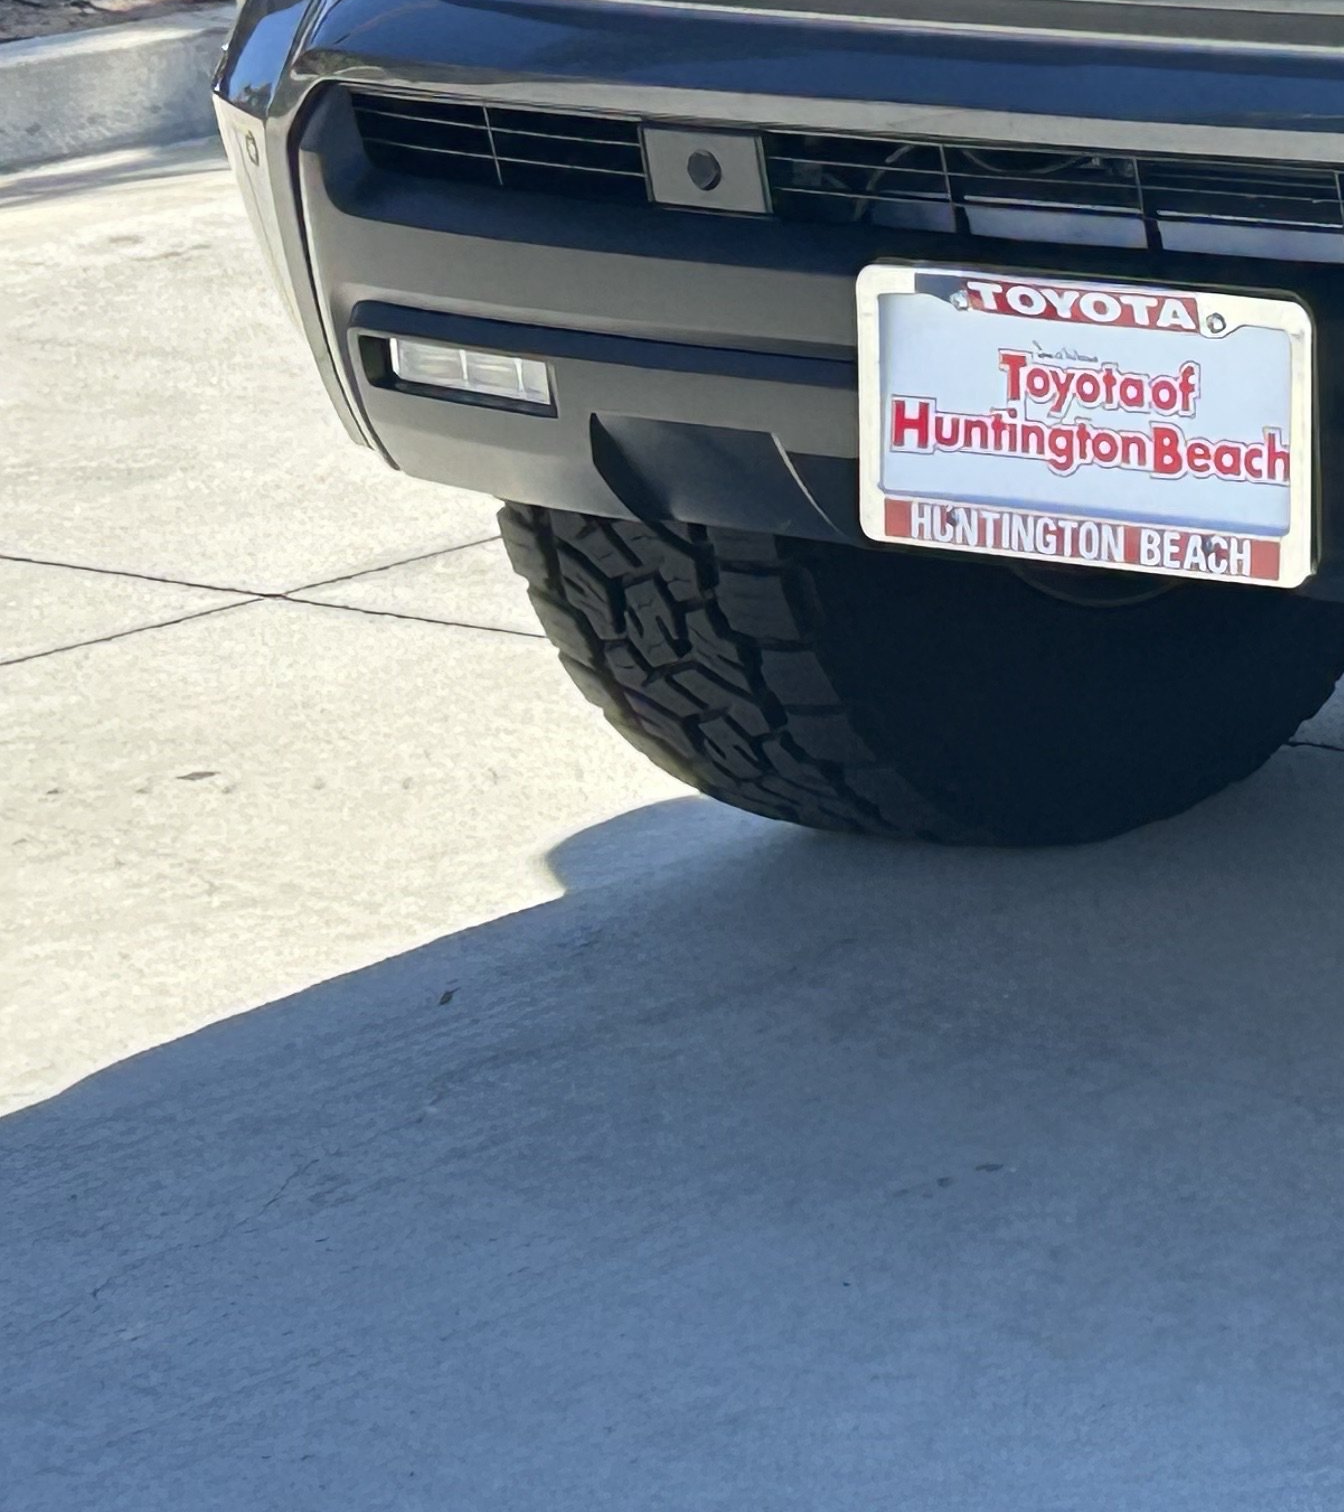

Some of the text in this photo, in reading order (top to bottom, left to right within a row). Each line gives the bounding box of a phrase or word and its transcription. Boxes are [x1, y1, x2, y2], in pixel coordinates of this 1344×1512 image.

[965, 281, 1198, 331] TOYOTA
[998, 350, 1197, 416] Toyota of
[891, 399, 1290, 482] Huntington Beach
[910, 502, 1252, 577] HUNTINGTON BEACH
